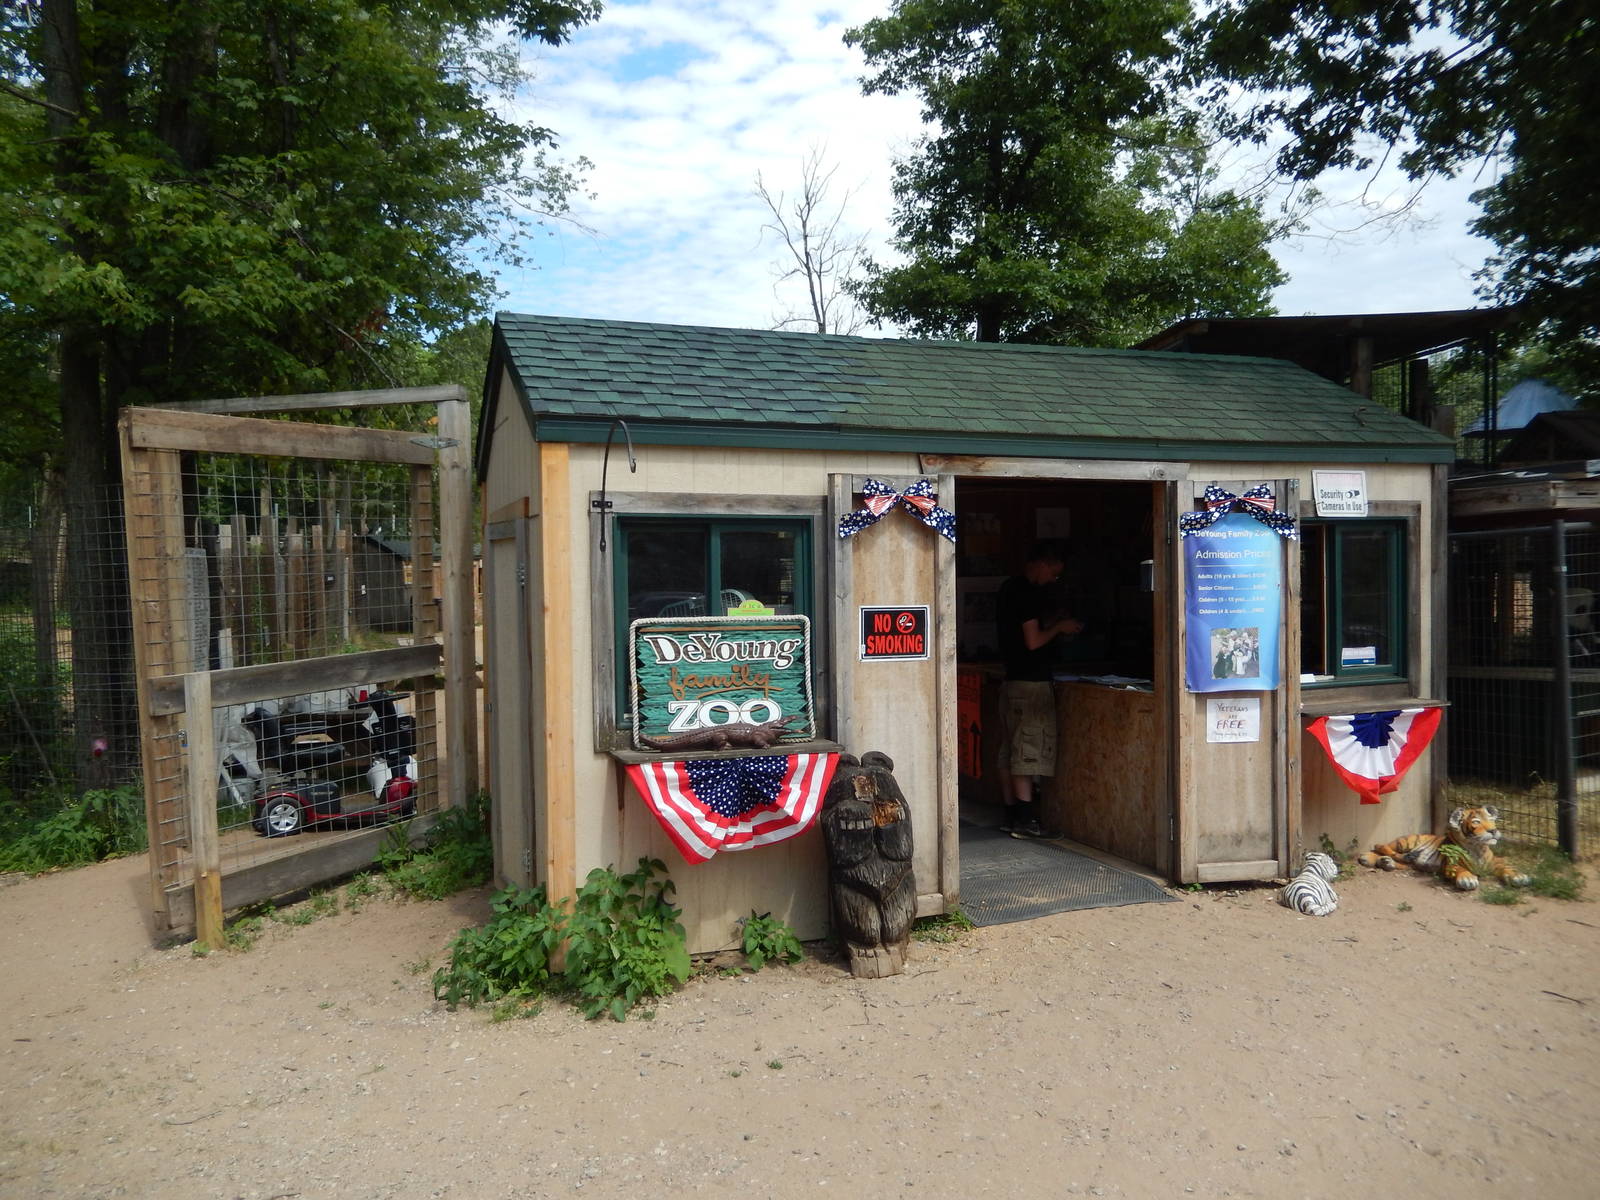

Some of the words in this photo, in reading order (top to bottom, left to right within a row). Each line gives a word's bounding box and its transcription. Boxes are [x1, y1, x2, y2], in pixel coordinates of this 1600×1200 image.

[1320, 489, 1344, 501] Security
[1320, 501, 1345, 511] Cameras
[1352, 501, 1363, 511] Use
[1195, 530, 1228, 540] DeYoung
[1228, 530, 1254, 540] Family
[1195, 550, 1242, 559] Admission
[874, 613, 892, 633] NO
[644, 633, 801, 670] DeYoung
[866, 634, 923, 654] SMOKING
[667, 664, 771, 700] family
[668, 699, 782, 733] ZOO
[1216, 719, 1246, 729] FREE
